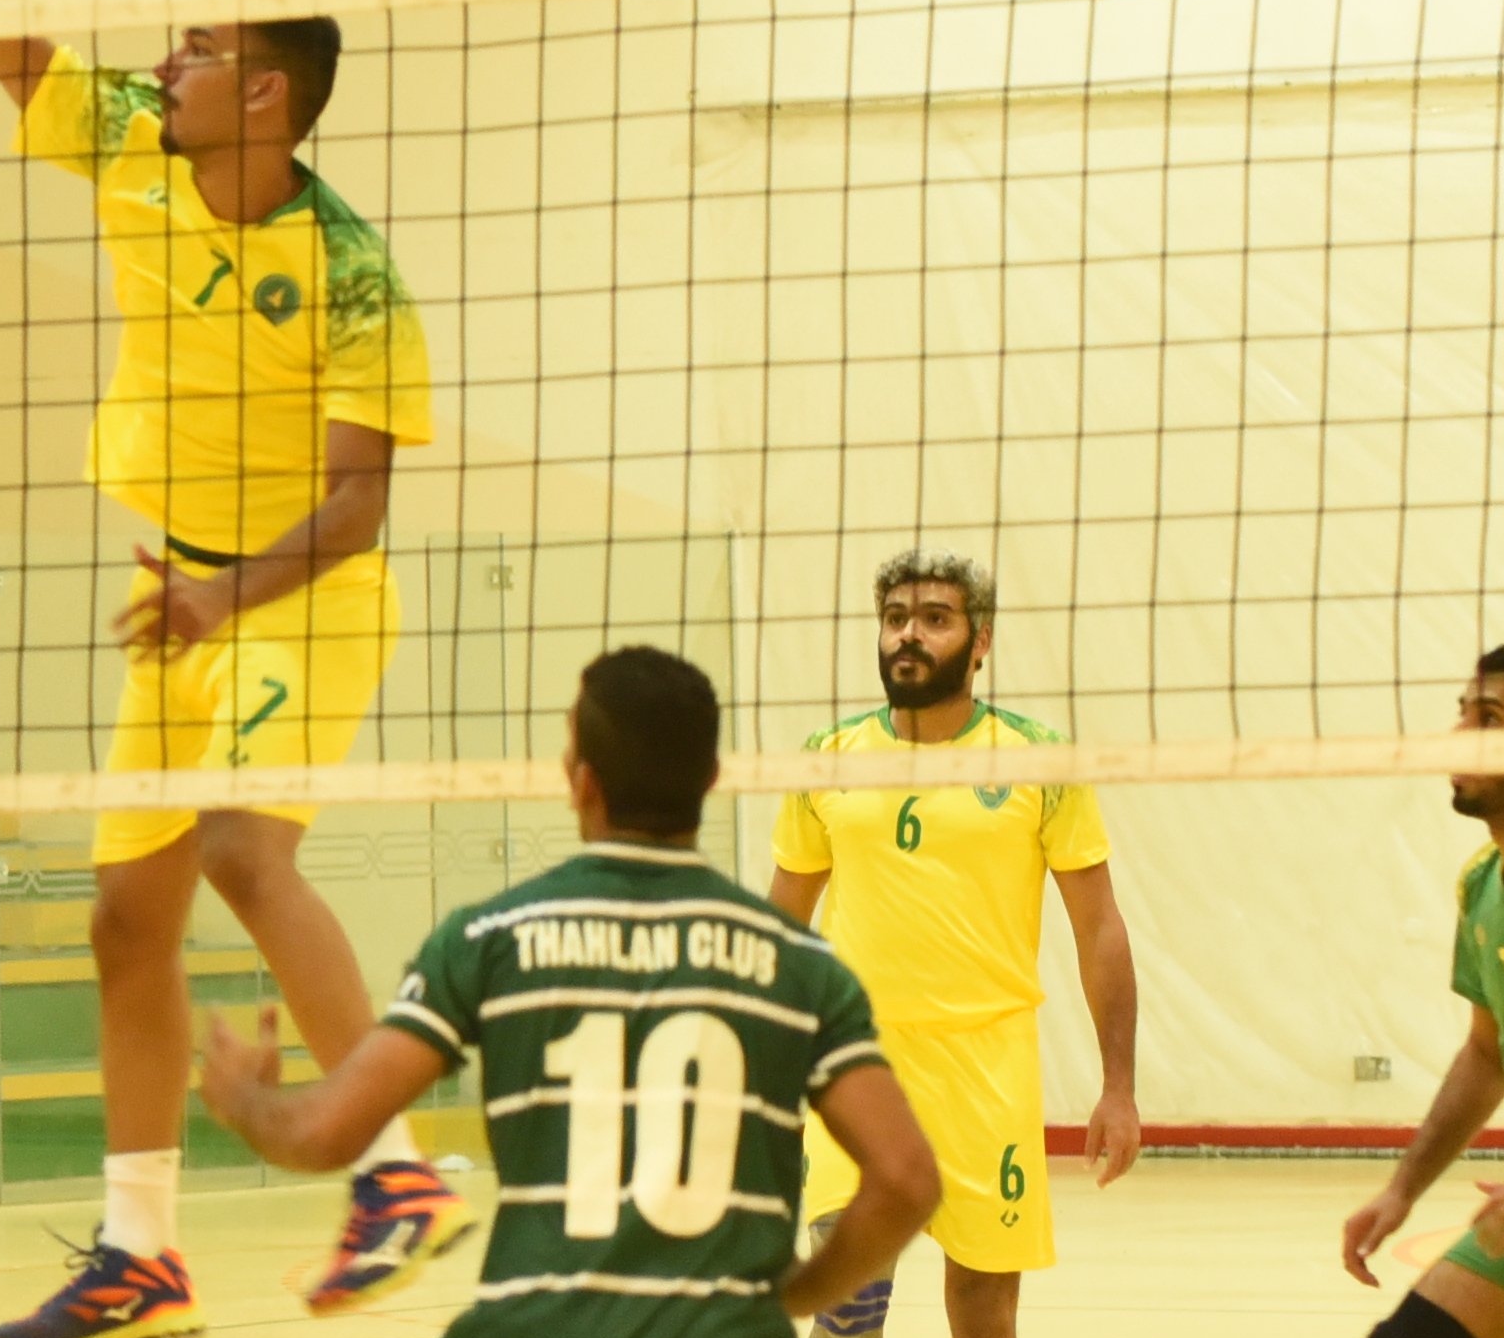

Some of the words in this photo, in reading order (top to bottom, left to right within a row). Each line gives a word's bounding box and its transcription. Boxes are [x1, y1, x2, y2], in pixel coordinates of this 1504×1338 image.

[193, 247, 233, 308] 7
[239, 676, 289, 736] 7
[895, 794, 922, 854] 6
[512, 918, 679, 973] THAHLAN
[687, 919, 778, 988] CLUB
[543, 1011, 747, 1240] 10
[999, 1143, 1025, 1203] 6
